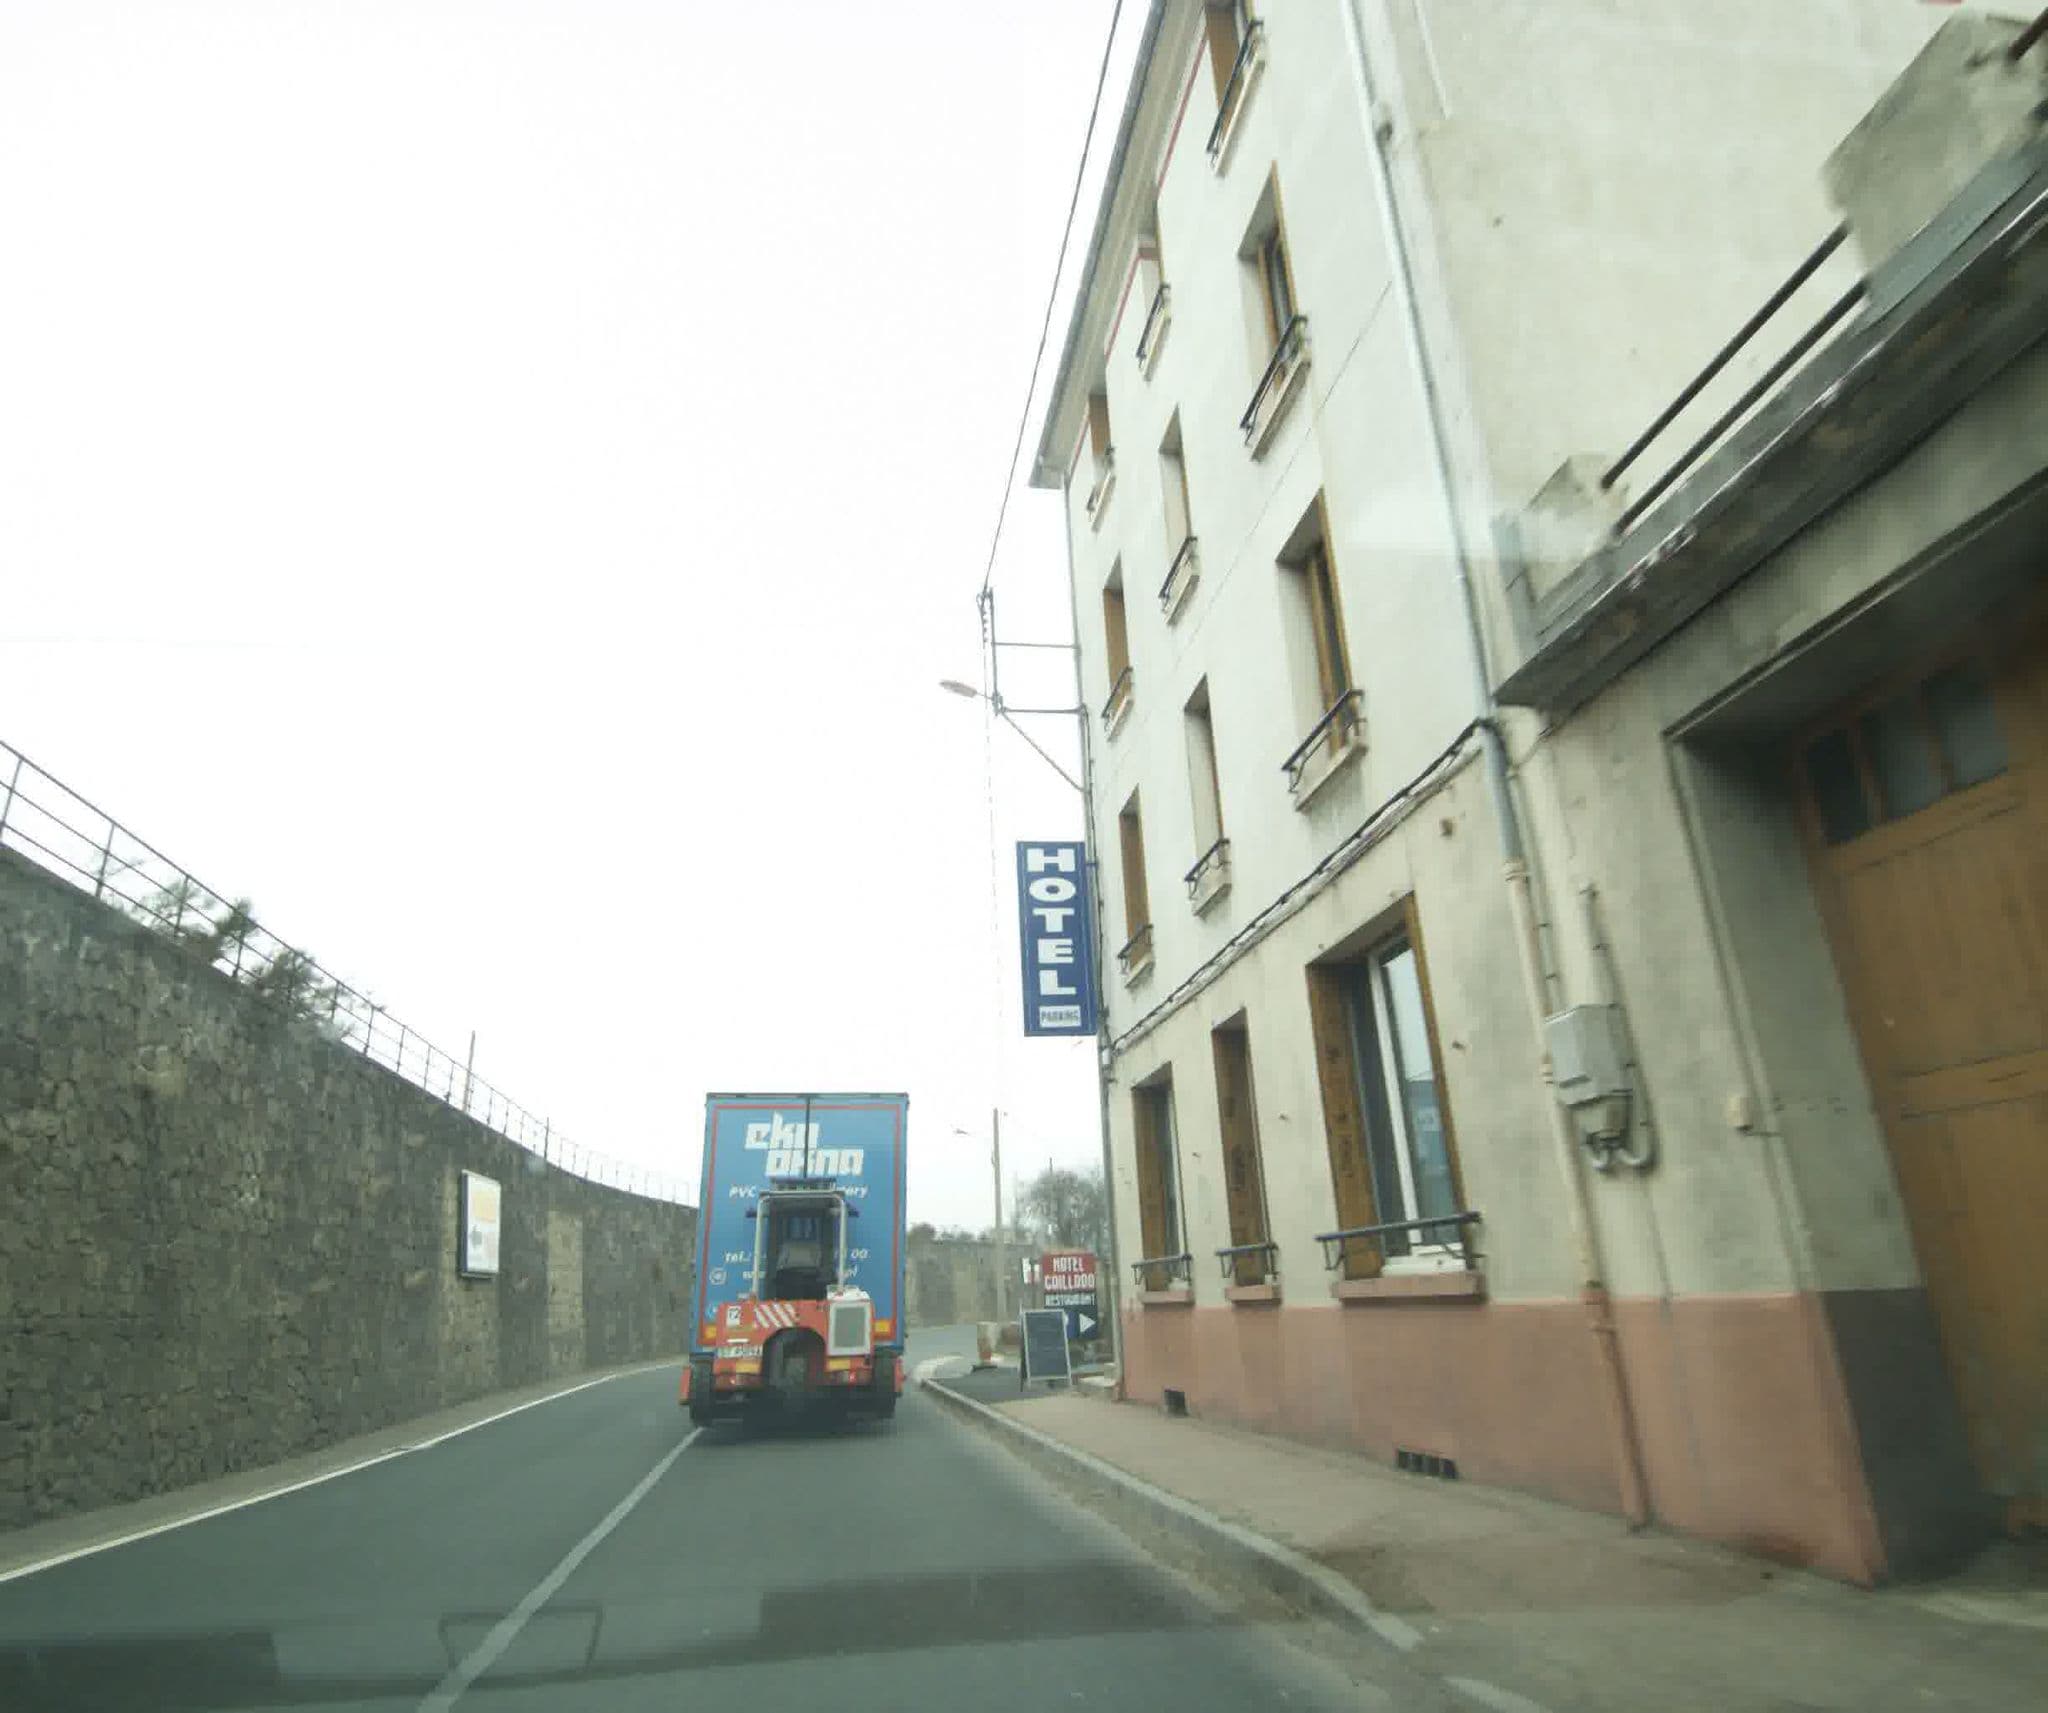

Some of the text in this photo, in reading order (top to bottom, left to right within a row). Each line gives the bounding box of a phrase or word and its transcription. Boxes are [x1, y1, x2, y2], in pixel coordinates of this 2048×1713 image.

[1026, 848, 1077, 996] HOTEL
[729, 1185, 757, 1198] PVC
[1053, 1256, 1084, 1272] HOTEL
